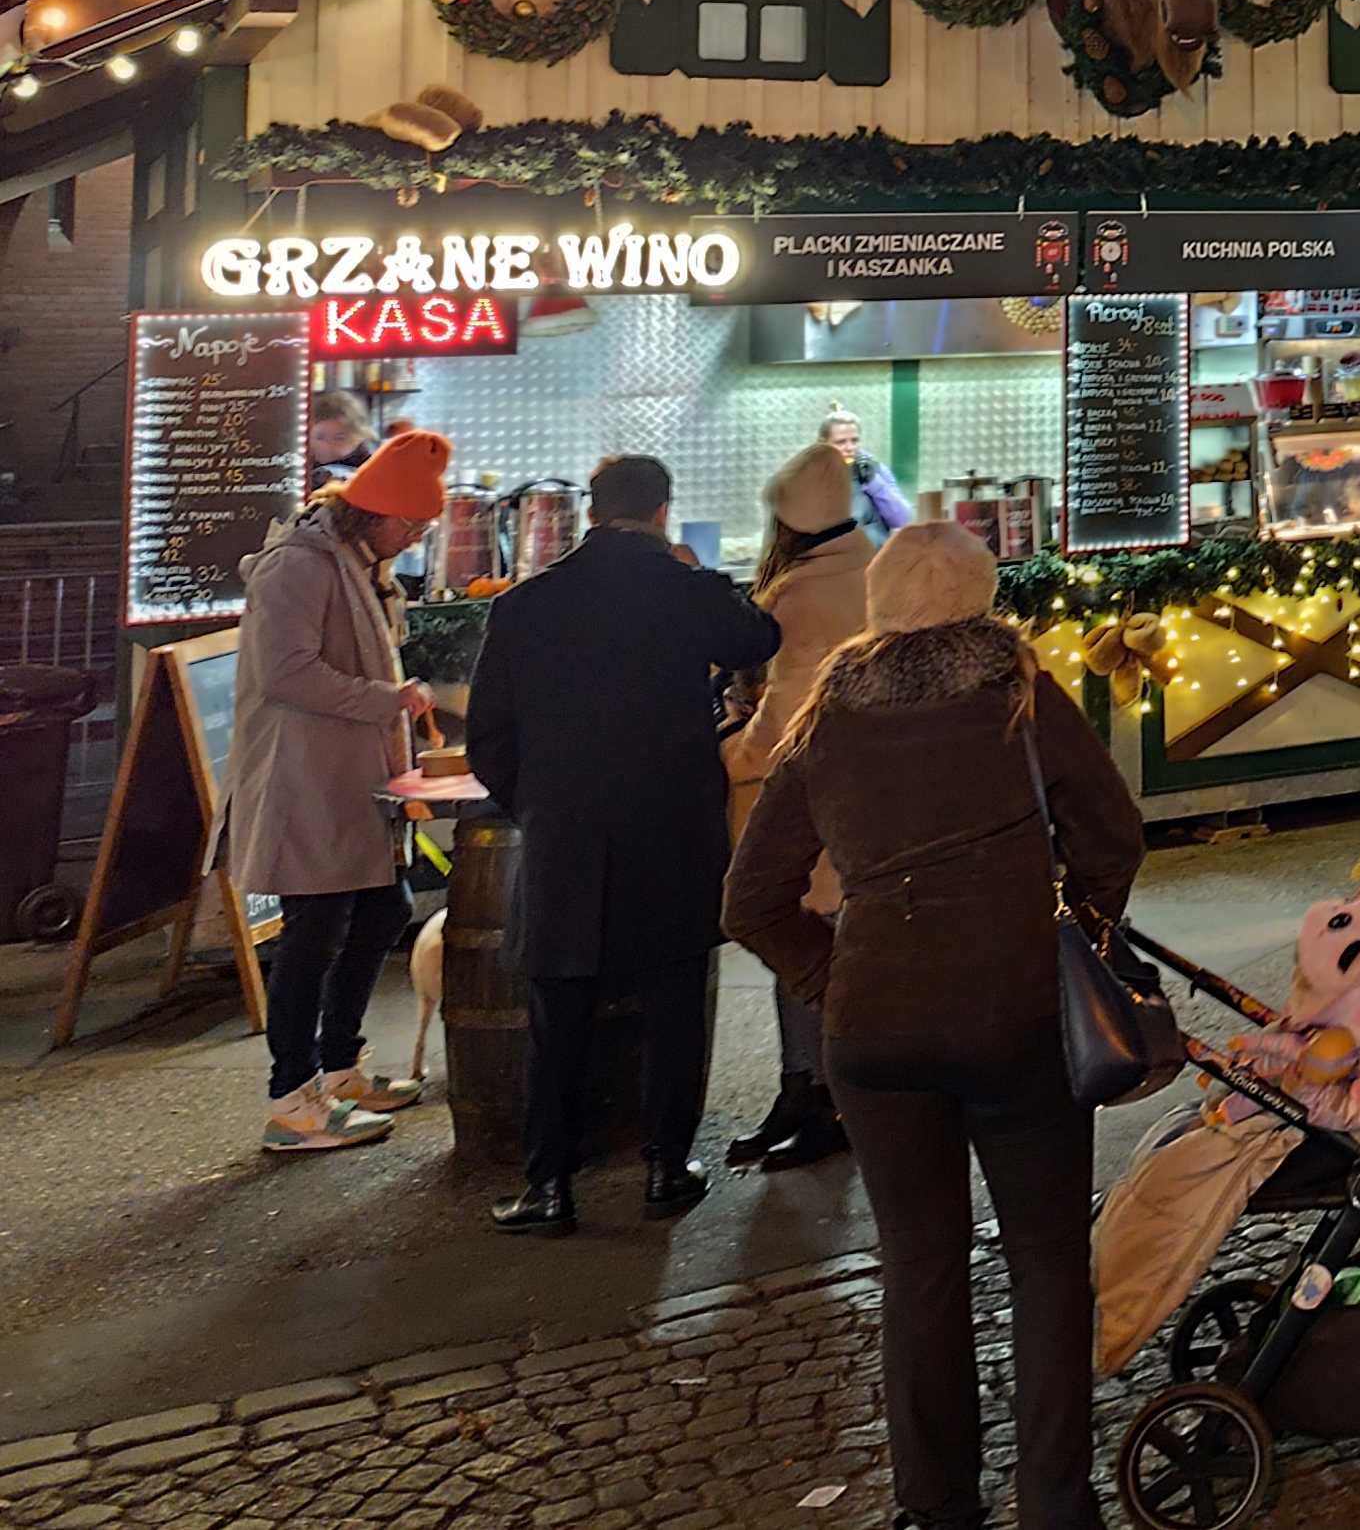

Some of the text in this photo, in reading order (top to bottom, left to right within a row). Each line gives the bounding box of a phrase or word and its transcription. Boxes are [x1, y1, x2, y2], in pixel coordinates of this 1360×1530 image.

[773, 233, 1005, 255] PLACKI ZMIENIACZANE
[1182, 238, 1336, 260] KUCHNIA POLSKA
[201, 223, 742, 297] GRZANE WINO
[827, 258, 954, 277] I KASZANKA
[324, 298, 507, 346] KASA
[169, 326, 267, 366] Napoje
